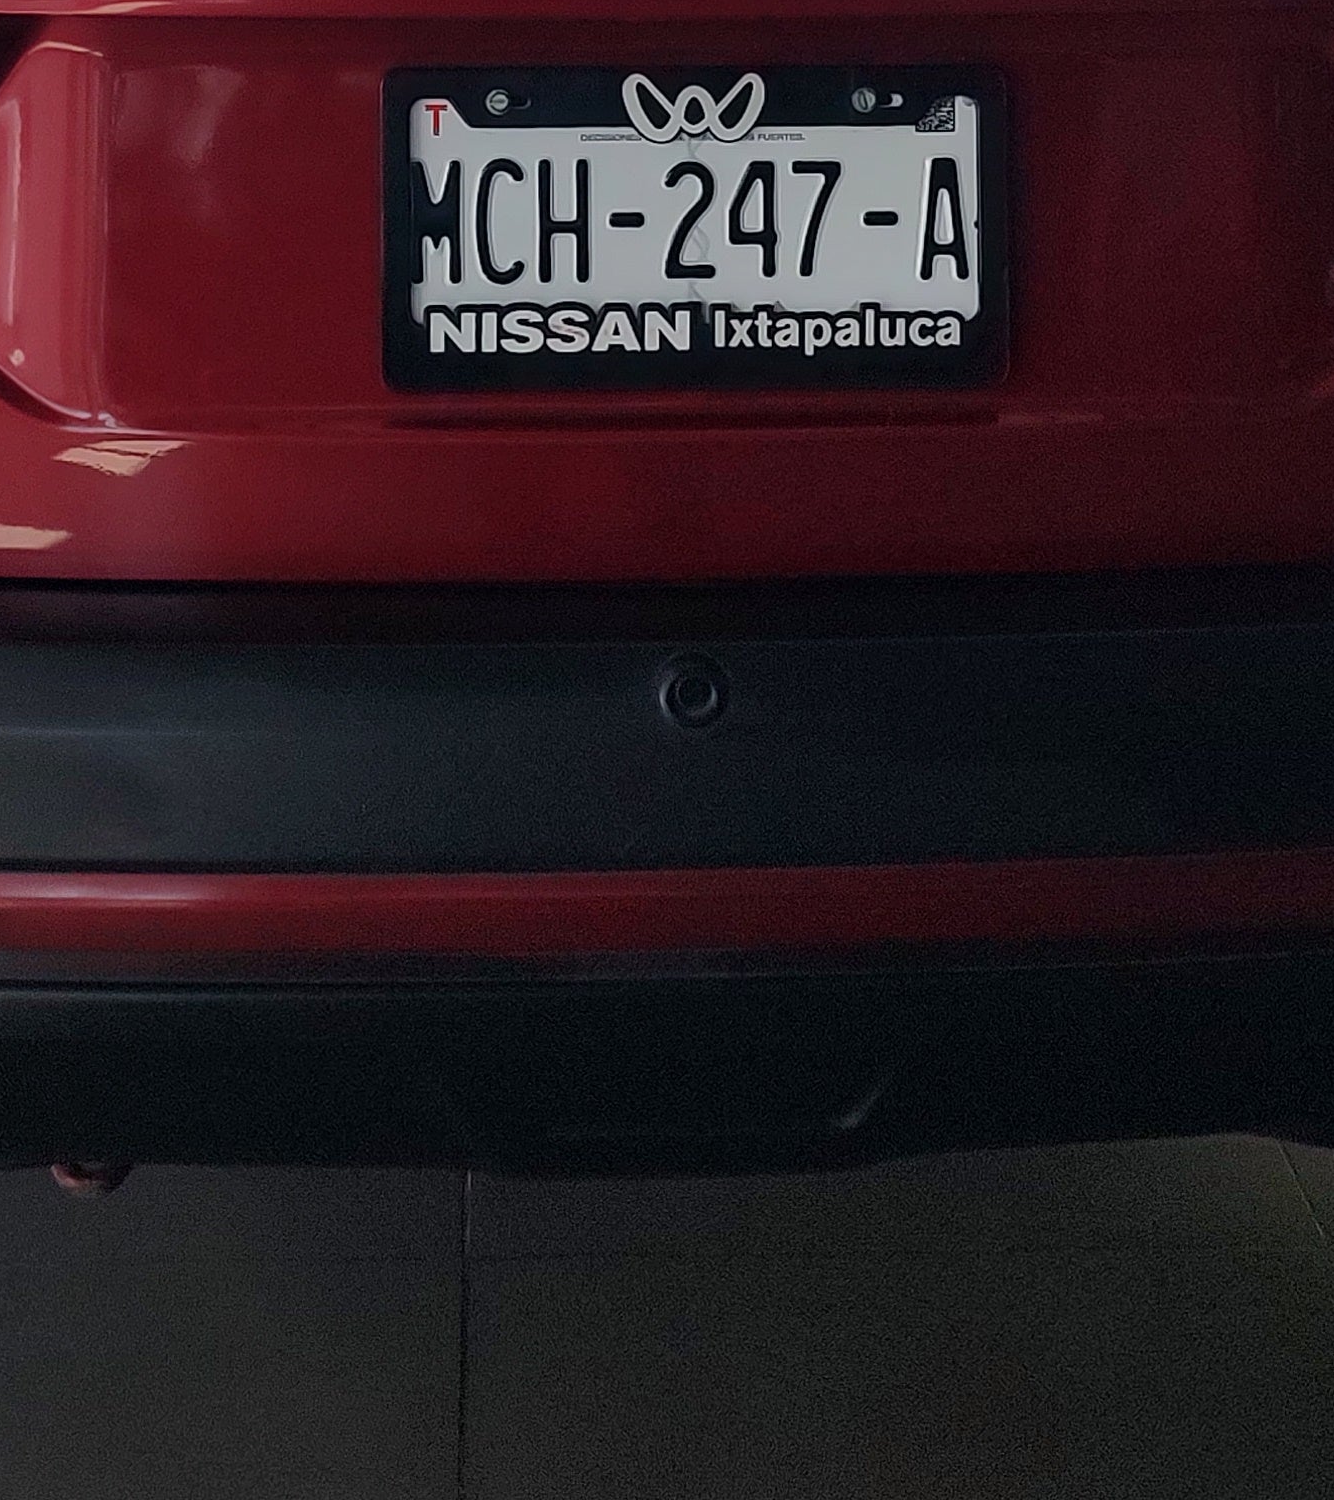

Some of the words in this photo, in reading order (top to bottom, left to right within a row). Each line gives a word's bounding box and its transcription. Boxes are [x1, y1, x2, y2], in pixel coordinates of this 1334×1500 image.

[425, 103, 448, 136] T
[411, 157, 970, 285] MCH-247-A
[429, 310, 692, 354] NISSAN
[714, 310, 962, 355] Ixtapaluca
